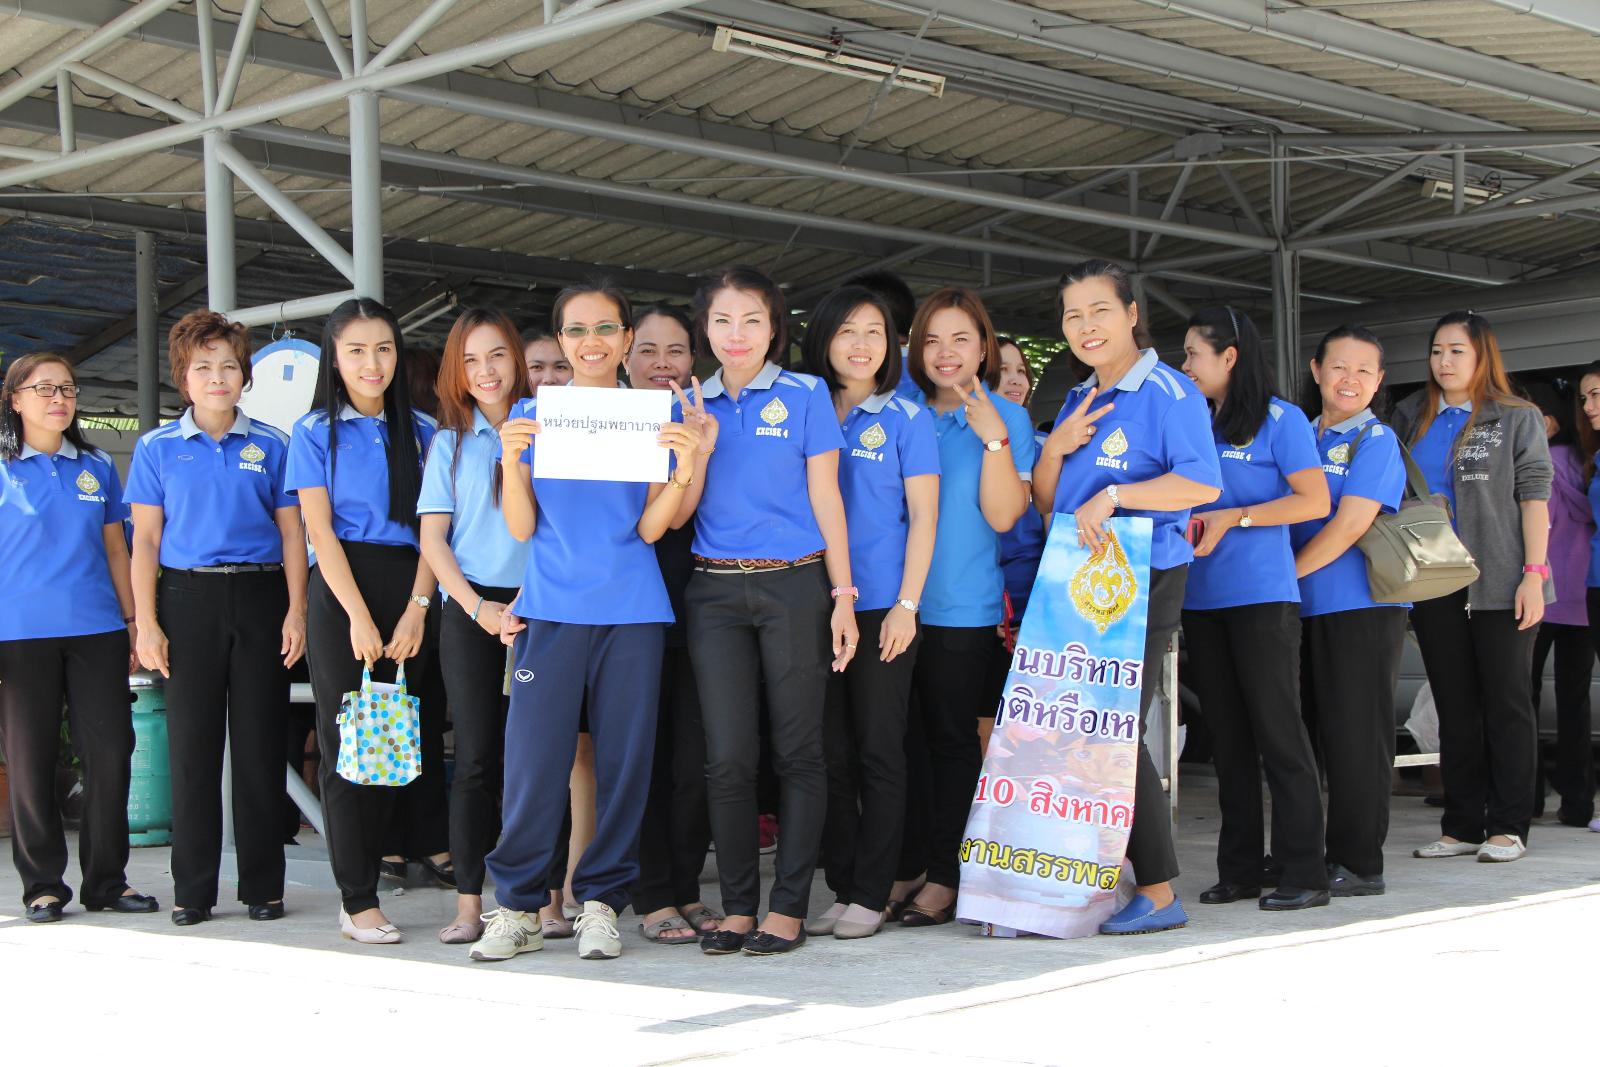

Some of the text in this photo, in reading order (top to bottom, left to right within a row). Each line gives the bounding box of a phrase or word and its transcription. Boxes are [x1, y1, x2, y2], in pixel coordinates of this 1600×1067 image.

[543, 413, 661, 434] หน่วยปฐมพยาบาล
[756, 426, 788, 439] EXCISE 4
[851, 449, 884, 462] EXCISE 4
[1245, 453, 1252, 462] 4
[1095, 456, 1128, 471] EXCISE 4
[1461, 473, 1489, 482] DELUXE
[976, 775, 1134, 828] 10 สิงหาค
